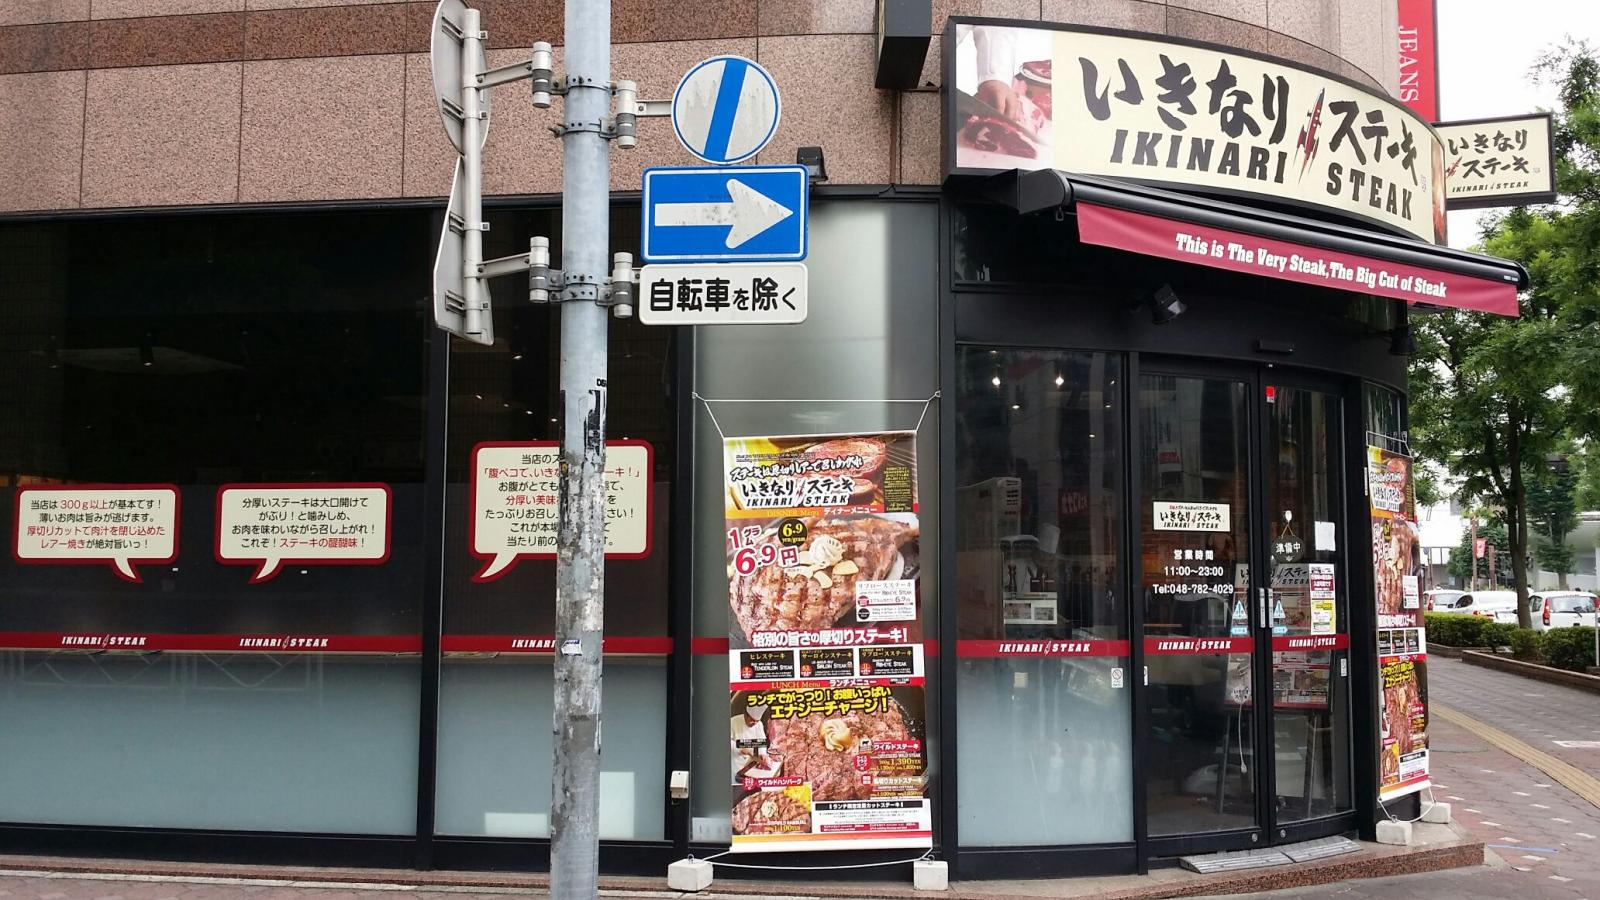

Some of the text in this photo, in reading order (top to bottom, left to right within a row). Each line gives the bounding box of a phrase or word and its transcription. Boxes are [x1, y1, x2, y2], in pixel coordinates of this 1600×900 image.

[1398, 26, 1419, 103] JEANS
[1078, 53, 1419, 186] いきなり ステーキ
[1448, 129, 1528, 155] いきなり
[1463, 155, 1529, 179] ステーキ
[1110, 129, 1413, 221] IKINARI STEAK
[1452, 181, 1528, 192] IKINARI STEAK
[1176, 233, 1208, 255] This
[1210, 240, 1224, 258] is
[1227, 242, 1254, 264] The
[1257, 248, 1287, 272] Very
[1356, 267, 1376, 288] Big
[1378, 271, 1399, 289] Cut
[1400, 276, 1413, 291] of
[1414, 278, 1447, 298] Steak
[650, 277, 796, 312] 自転車を除く
[742, 478, 853, 497] いきなり ステーキ
[242, 497, 368, 508] 分厚いステーキは大口開けて
[747, 495, 847, 507] IKINARI STEAK
[1160, 511, 1221, 522] いきなり ステーキ
[27, 526, 165, 536] 厚切りカットで肉汁を閉じ込めた
[782, 523, 803, 537] 6.9
[1276, 542, 1300, 554] 準備中
[1174, 549, 1213, 560] 営業時間
[1153, 584, 1233, 594] Tel:048-782-4029
[62, 637, 146, 646] IKINARI STEAK
[239, 638, 328, 648] IKINARI STEAK
[511, 639, 556, 648] IKINARI
[1158, 640, 1231, 650] IKINARI STEAK
[1289, 638, 1336, 647] IKINARI STEAK
[999, 644, 1090, 653] IKINARI STEAK
[830, 679, 877, 687] ランチメニュー
[770, 698, 888, 719] エナジーチャージ！
